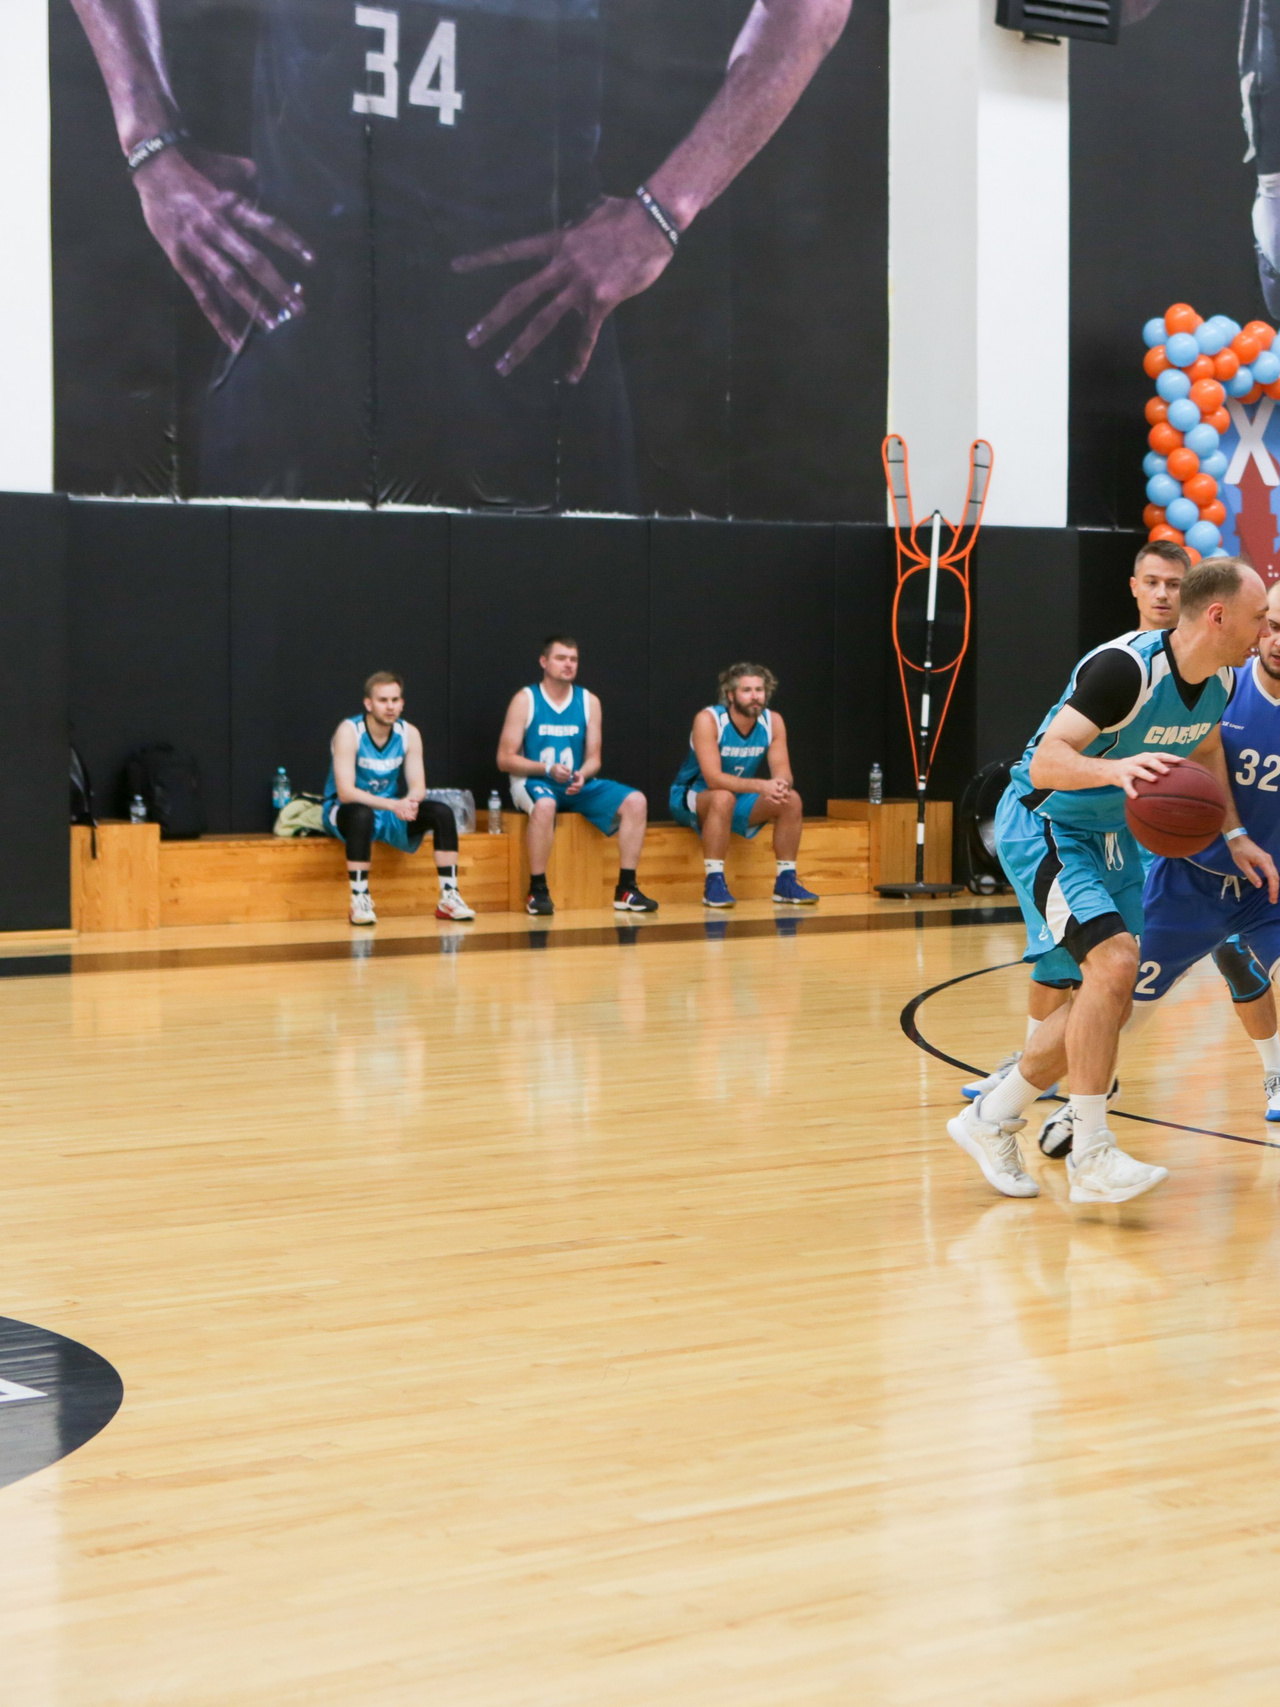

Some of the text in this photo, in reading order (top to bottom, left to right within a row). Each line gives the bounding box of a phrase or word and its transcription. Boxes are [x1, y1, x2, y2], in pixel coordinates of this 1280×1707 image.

[352, 6, 463, 126] 34
[734, 765, 745, 777] 7
[1134, 960, 1161, 994] 2
